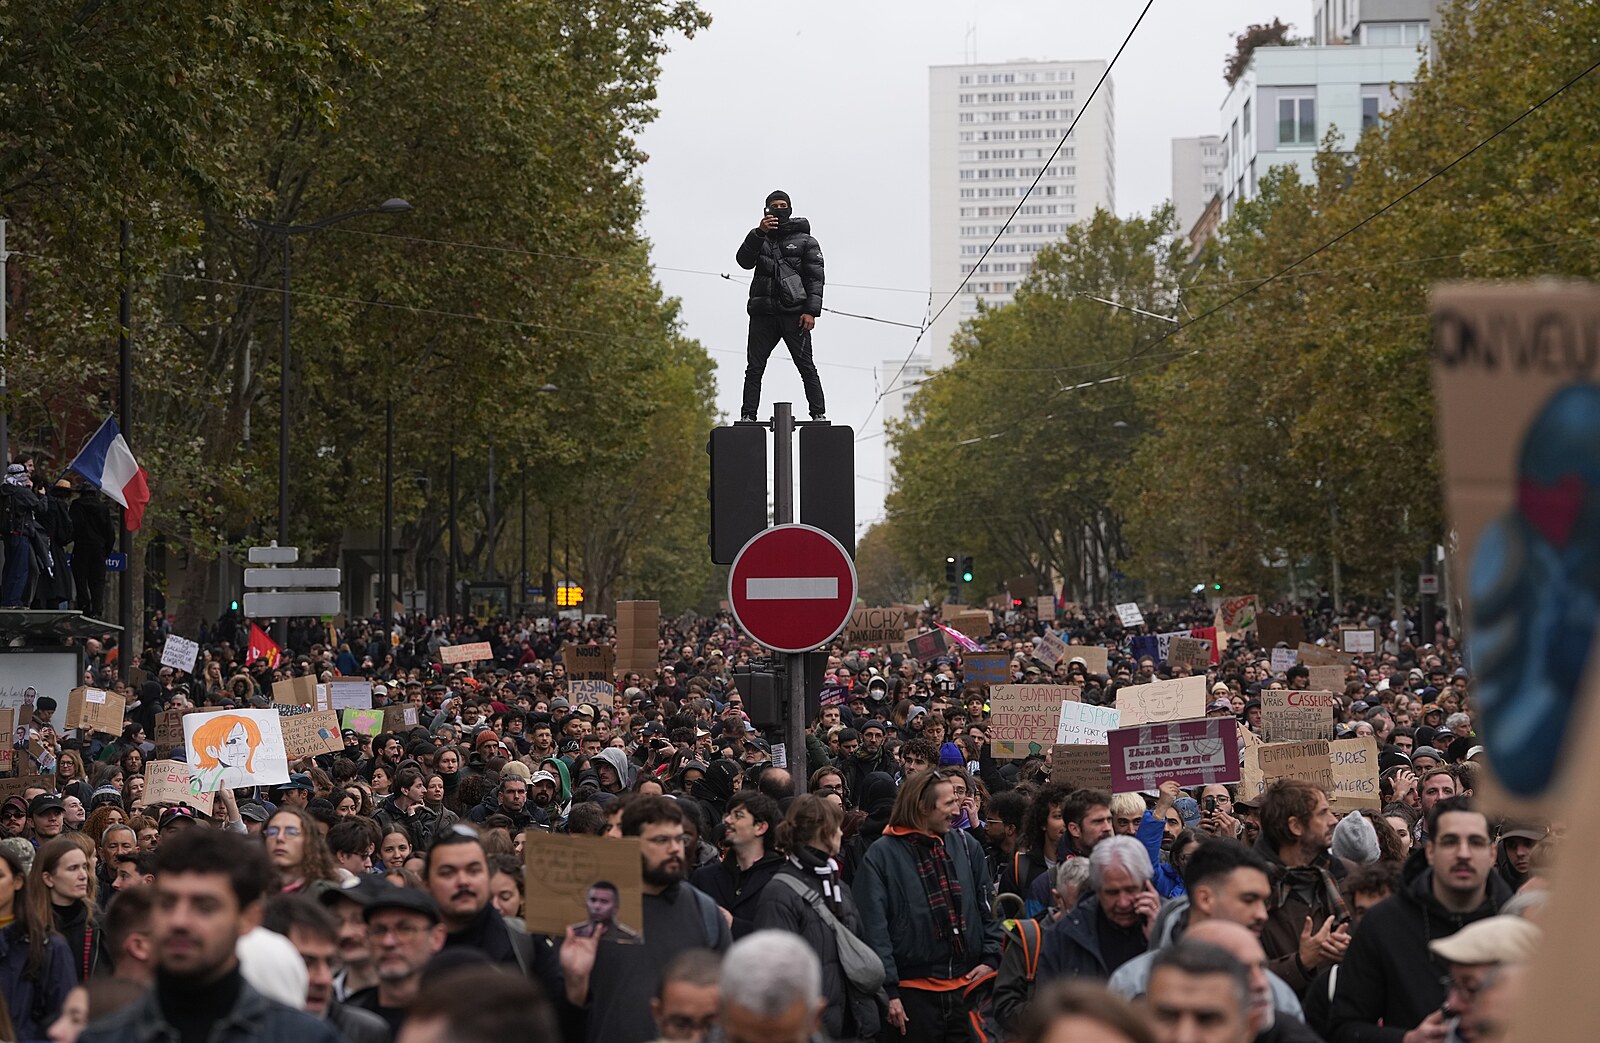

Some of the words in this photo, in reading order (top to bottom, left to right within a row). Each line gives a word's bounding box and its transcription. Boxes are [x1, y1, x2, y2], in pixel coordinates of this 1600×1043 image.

[850, 610, 903, 628] VICHY
[575, 646, 601, 657] NOUS
[571, 680, 613, 696] FASHION
[1020, 687, 1080, 702] GUYANAIS
[576, 692, 599, 703] PAS
[1263, 697, 1284, 706] VRAIS
[1287, 691, 1334, 707] CASSEURS
[1017, 703, 1041, 712] sont
[990, 713, 1047, 727] CITOYENS
[1063, 703, 1119, 729] L'ESPOIR
[990, 727, 1038, 740] SECONDE
[1059, 722, 1080, 734] PLUS
[1083, 727, 1100, 737] FORT
[307, 742, 324, 753] ANS
[1263, 745, 1301, 762] ENFANTS
[1129, 753, 1212, 771] DELACQUIS
